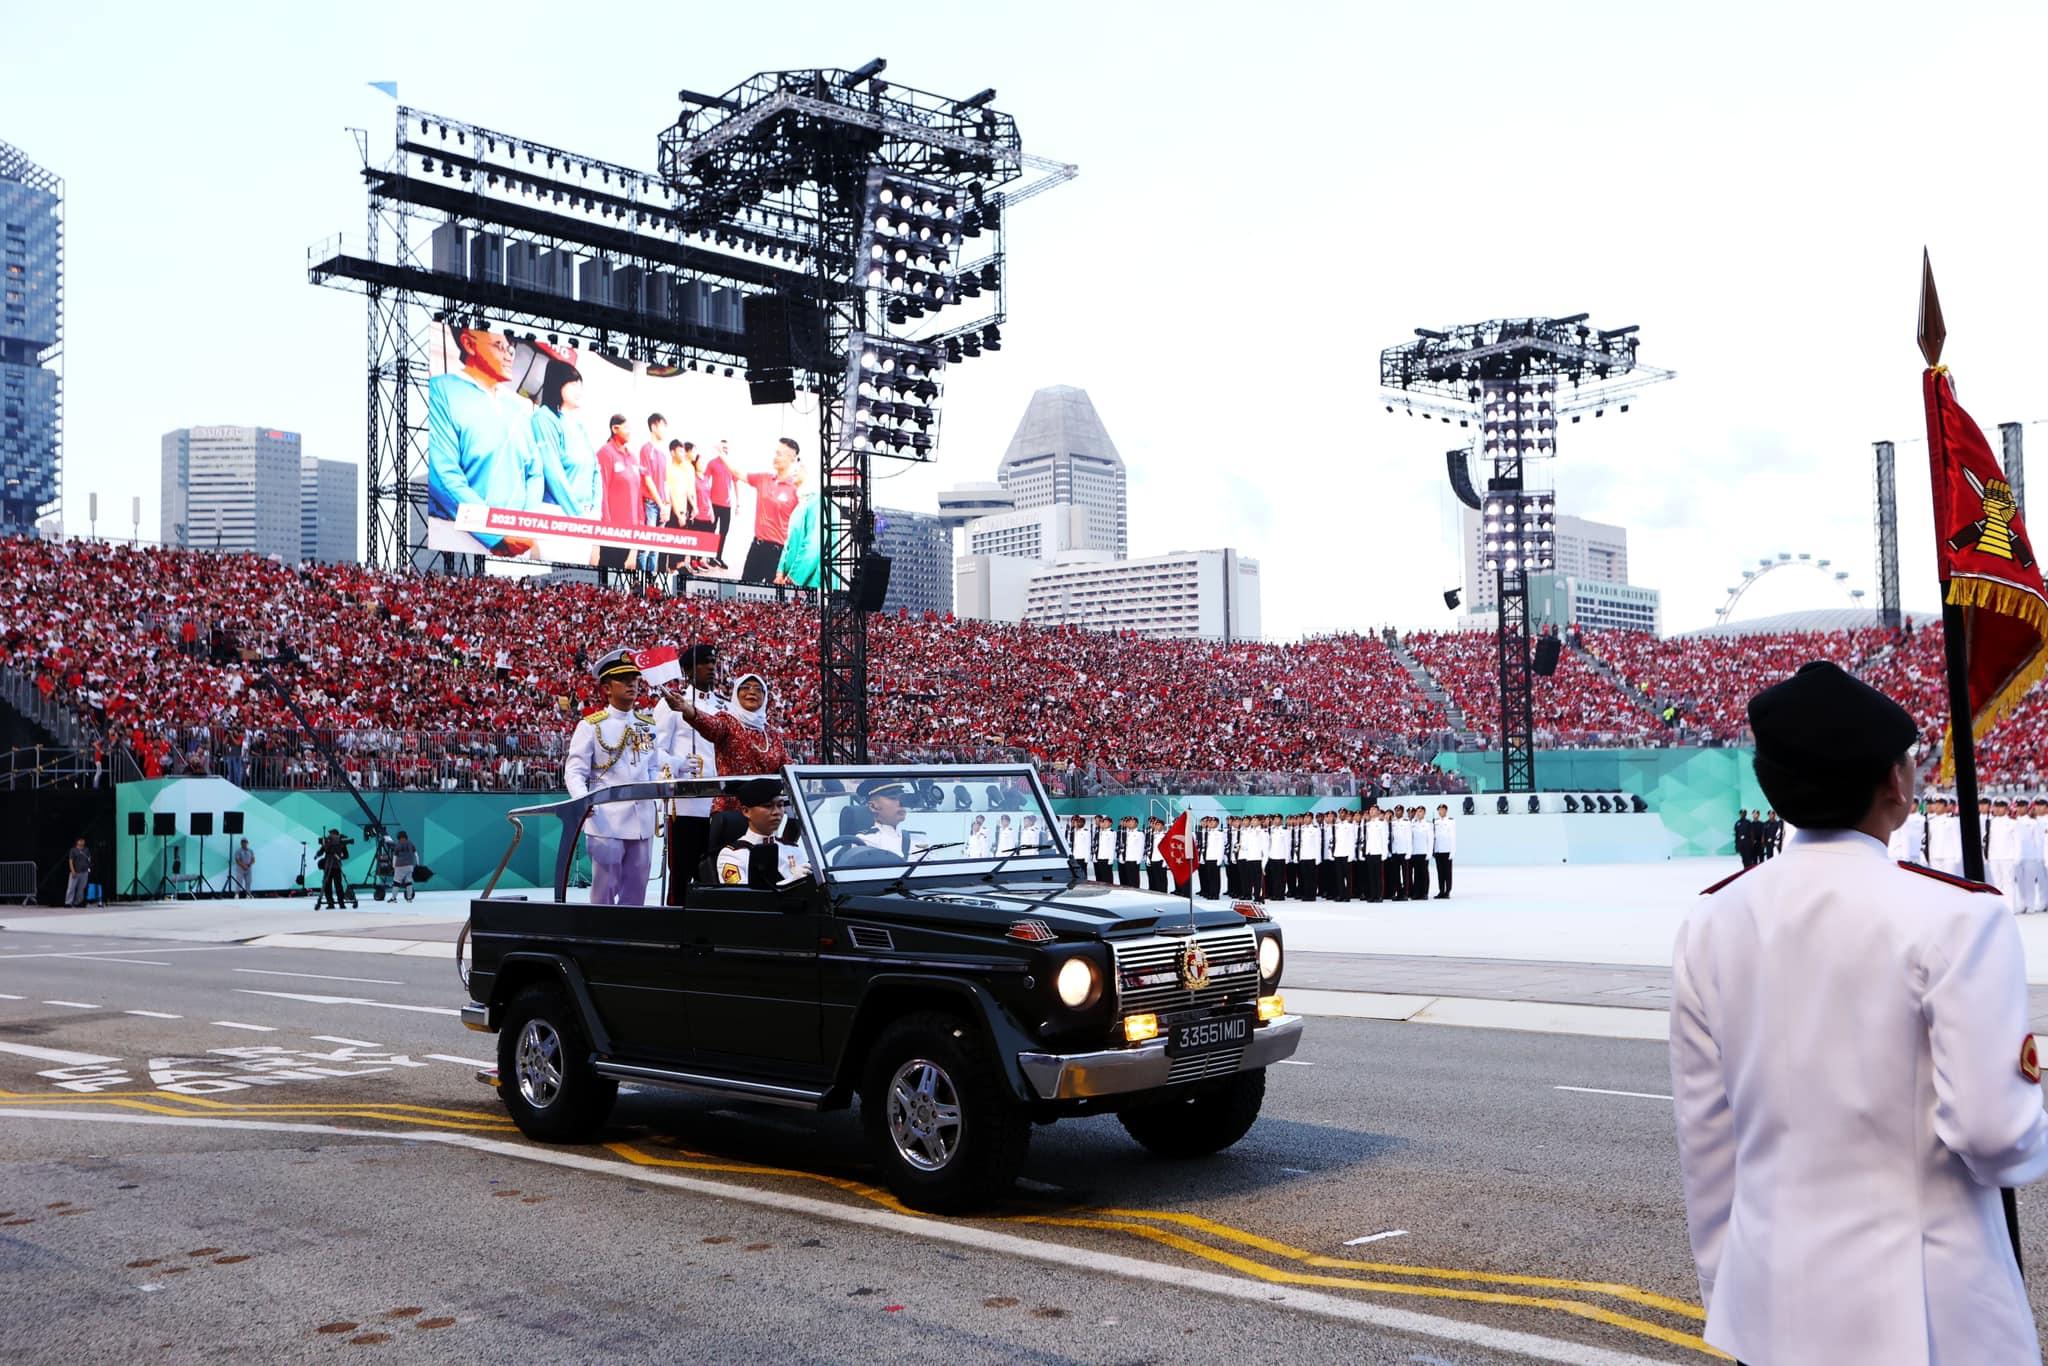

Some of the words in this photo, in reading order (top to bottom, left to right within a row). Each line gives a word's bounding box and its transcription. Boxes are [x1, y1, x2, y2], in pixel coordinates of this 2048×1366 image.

[518, 517, 549, 530] TOTAL
[551, 520, 593, 534] DEFENCE
[595, 524, 632, 539] PARADE
[633, 530, 698, 546] PARTICIPANTS
[1576, 583, 1618, 596] MANDARIN
[1621, 589, 1657, 602] ORIENTAL
[1179, 1019, 1246, 1048] 33551MID
